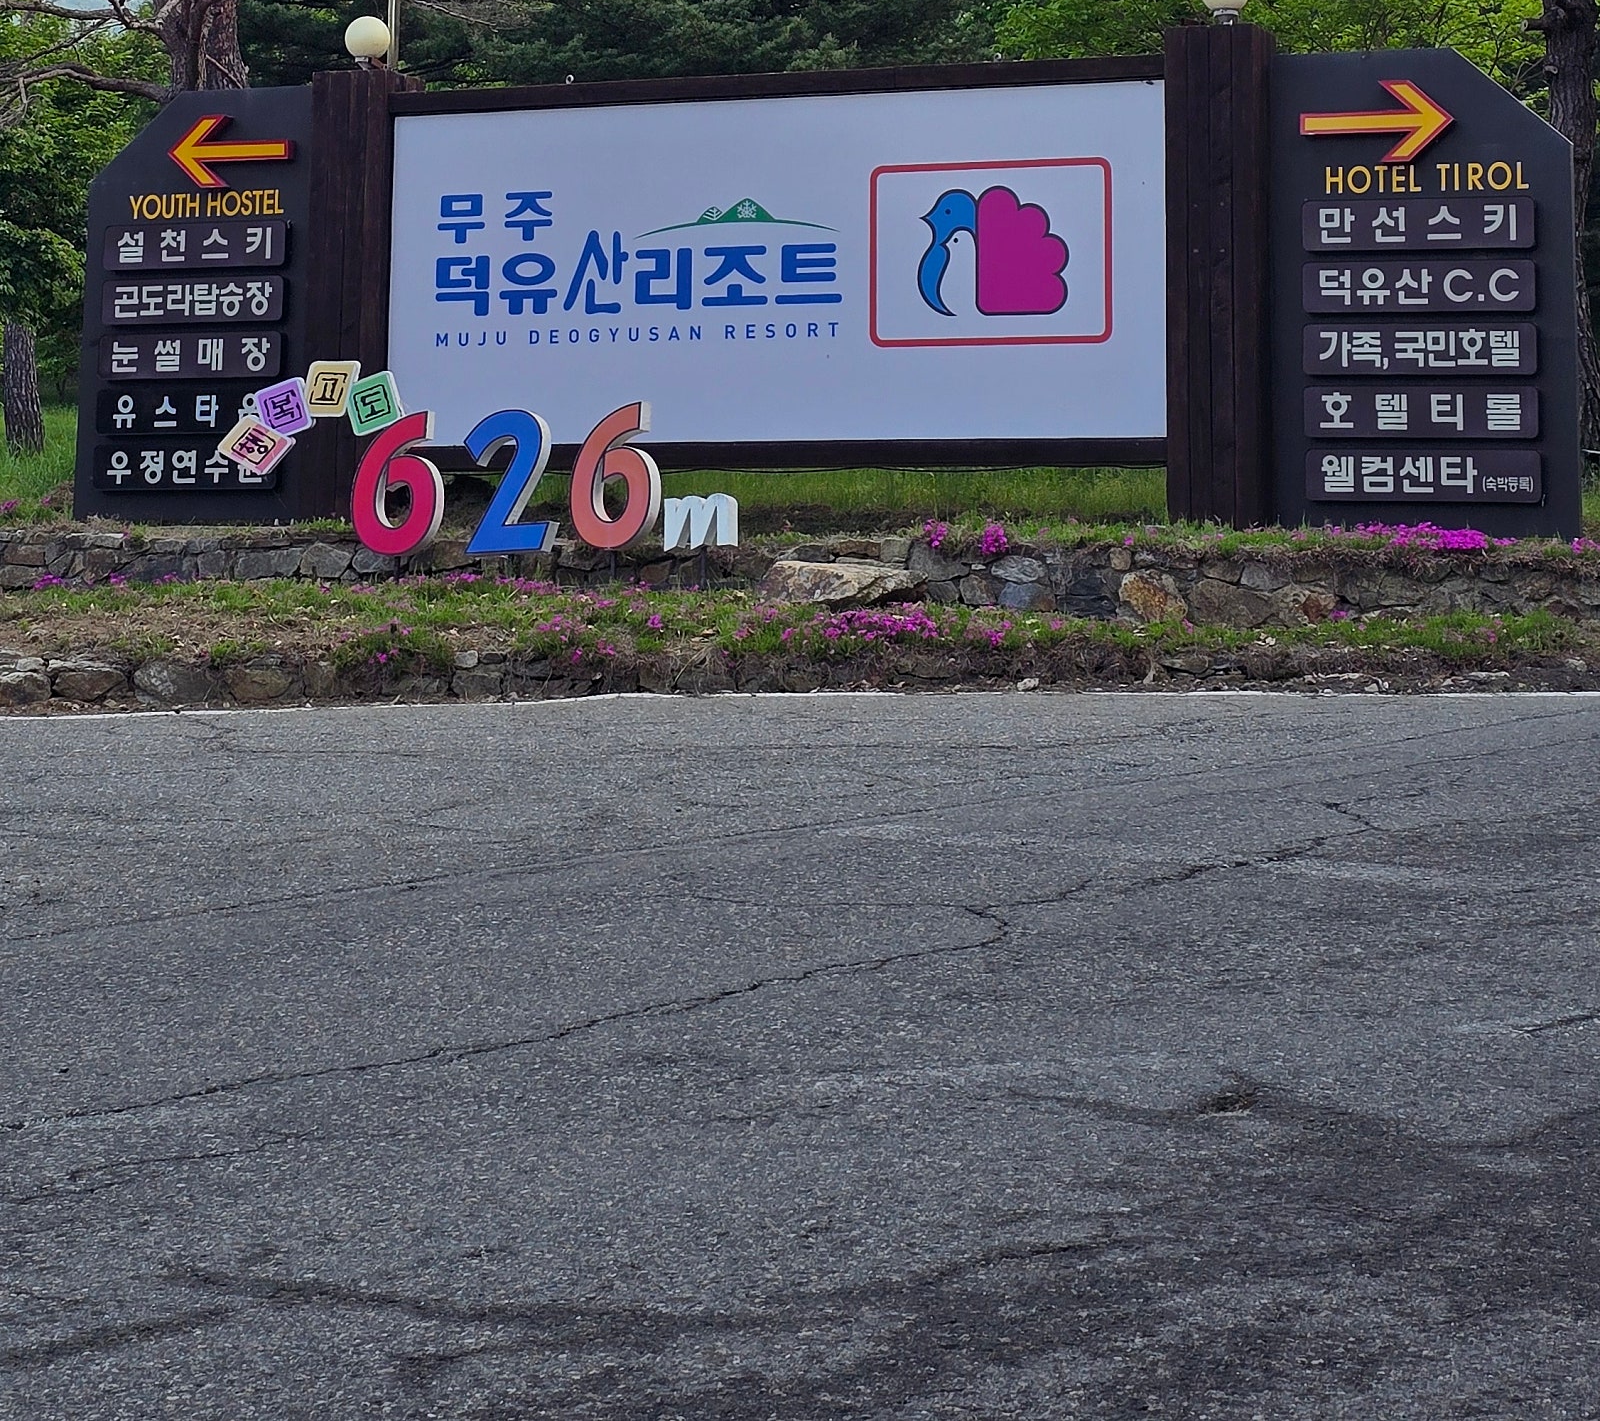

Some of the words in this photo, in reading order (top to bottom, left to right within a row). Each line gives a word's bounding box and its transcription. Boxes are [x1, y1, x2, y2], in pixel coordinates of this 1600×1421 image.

[1325, 163, 1422, 194] HOTEL
[1436, 161, 1530, 191] TIROL
[129, 192, 200, 220] YOUTH
[206, 188, 284, 217] HOSTEL
[437, 190, 554, 244] 무주
[1319, 204, 1517, 244] 만선스키
[116, 226, 273, 264] 설천스키
[434, 229, 843, 317] 덕유산리조트
[113, 280, 273, 319] 곤도라탑승장
[436, 330, 509, 347] MUJU
[528, 324, 703, 346] DEOGYUSAN
[724, 321, 840, 340] RESORT
[111, 336, 271, 373] 눈썰매장
[1319, 392, 1522, 432] 호텔티롤
